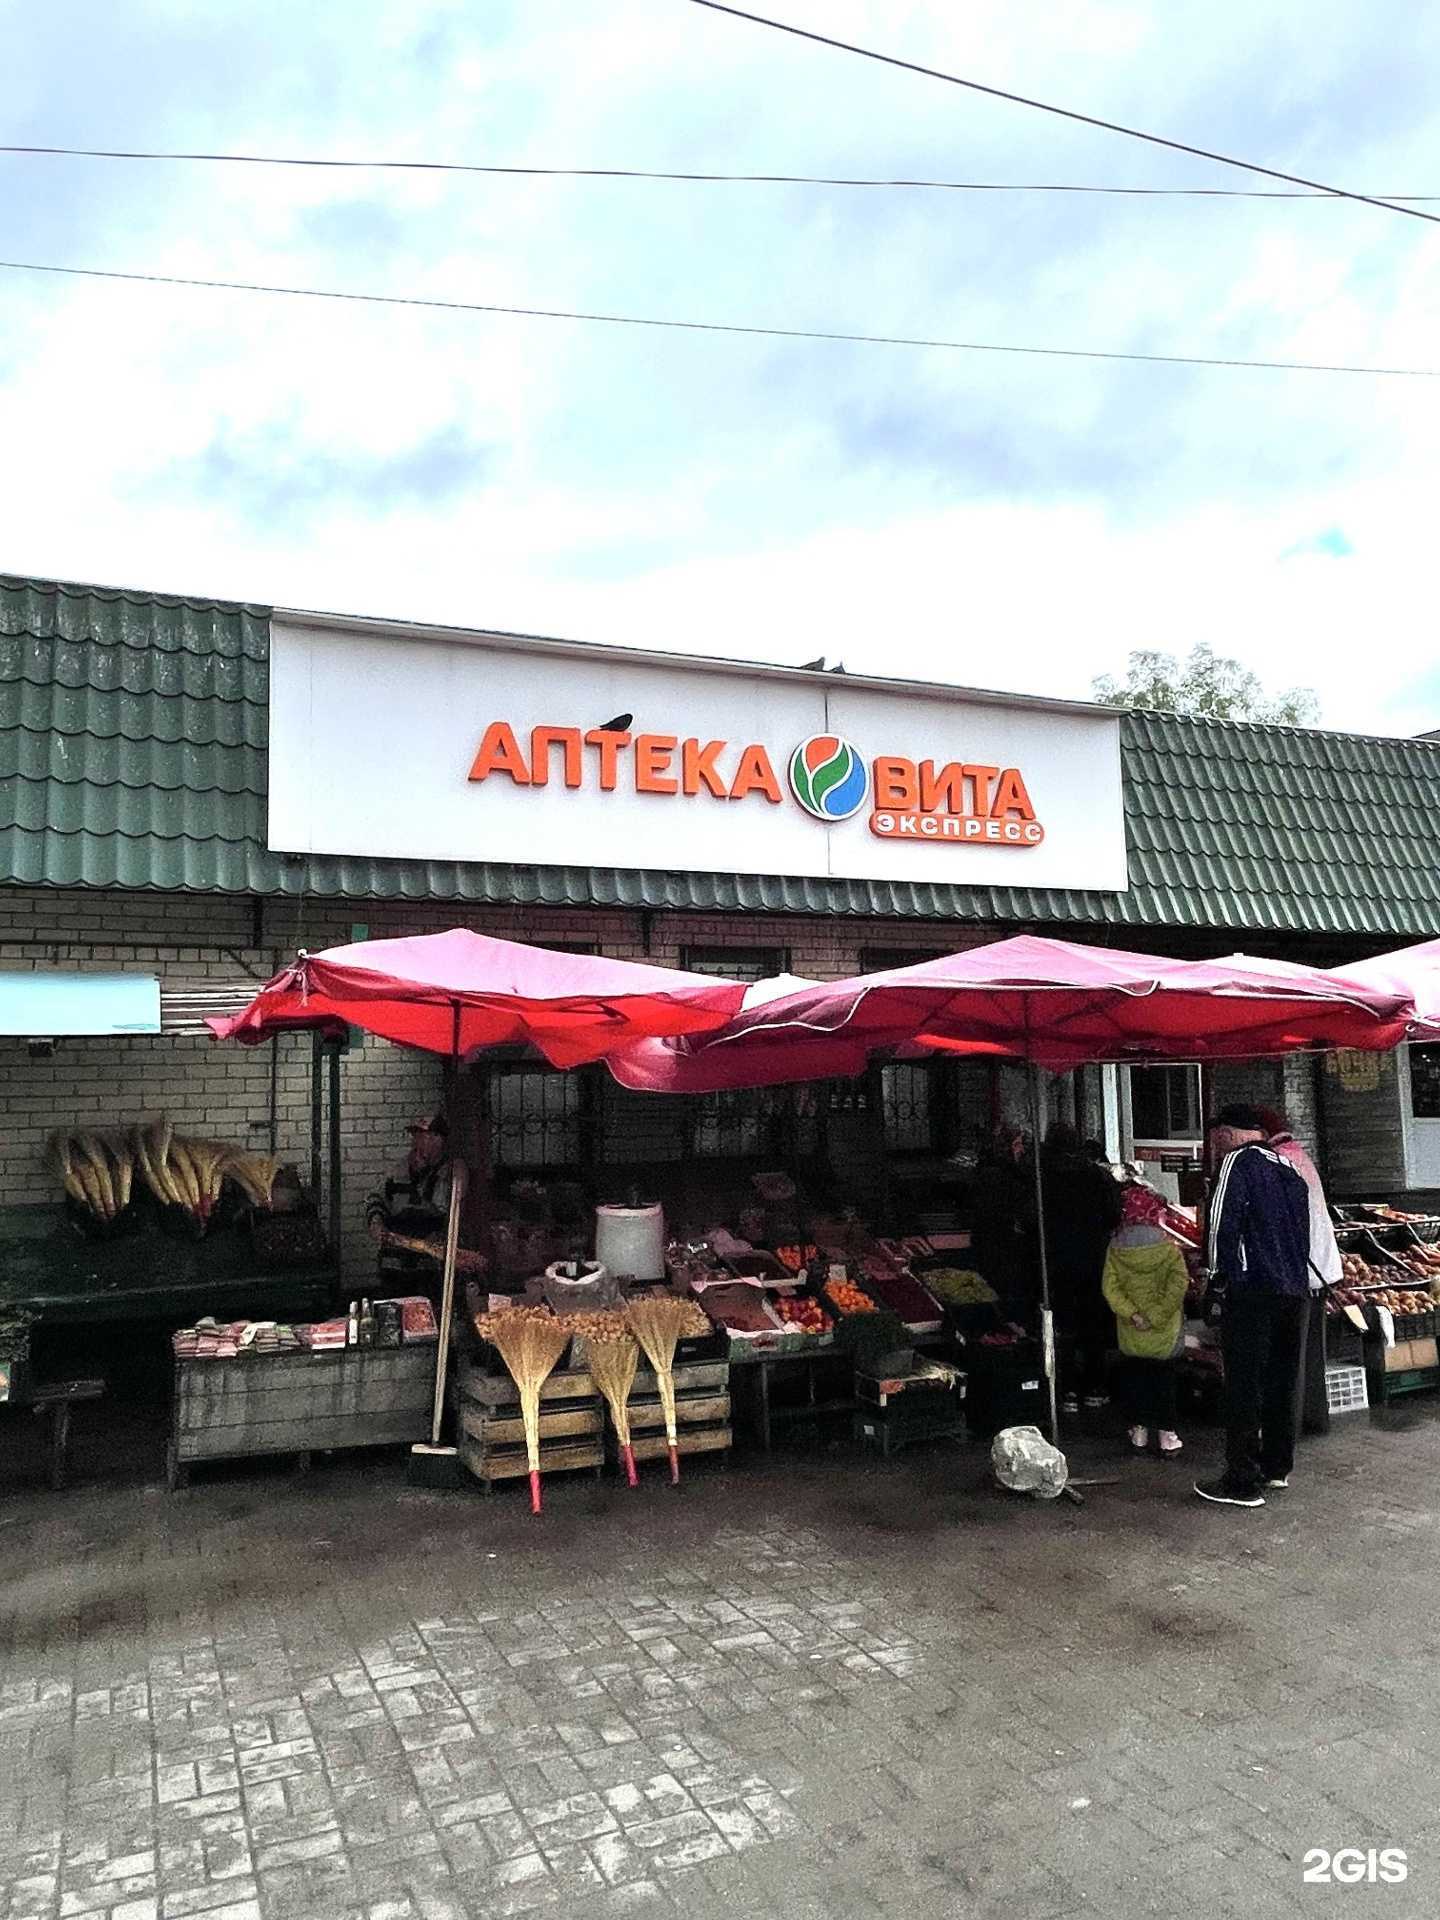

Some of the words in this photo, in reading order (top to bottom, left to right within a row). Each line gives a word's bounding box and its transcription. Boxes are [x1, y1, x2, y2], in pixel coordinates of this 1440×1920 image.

[468, 721, 784, 803] АПТЕКА
[873, 756, 1036, 820] ВИТА
[876, 813, 1041, 842] ЭКСПРЕСС
